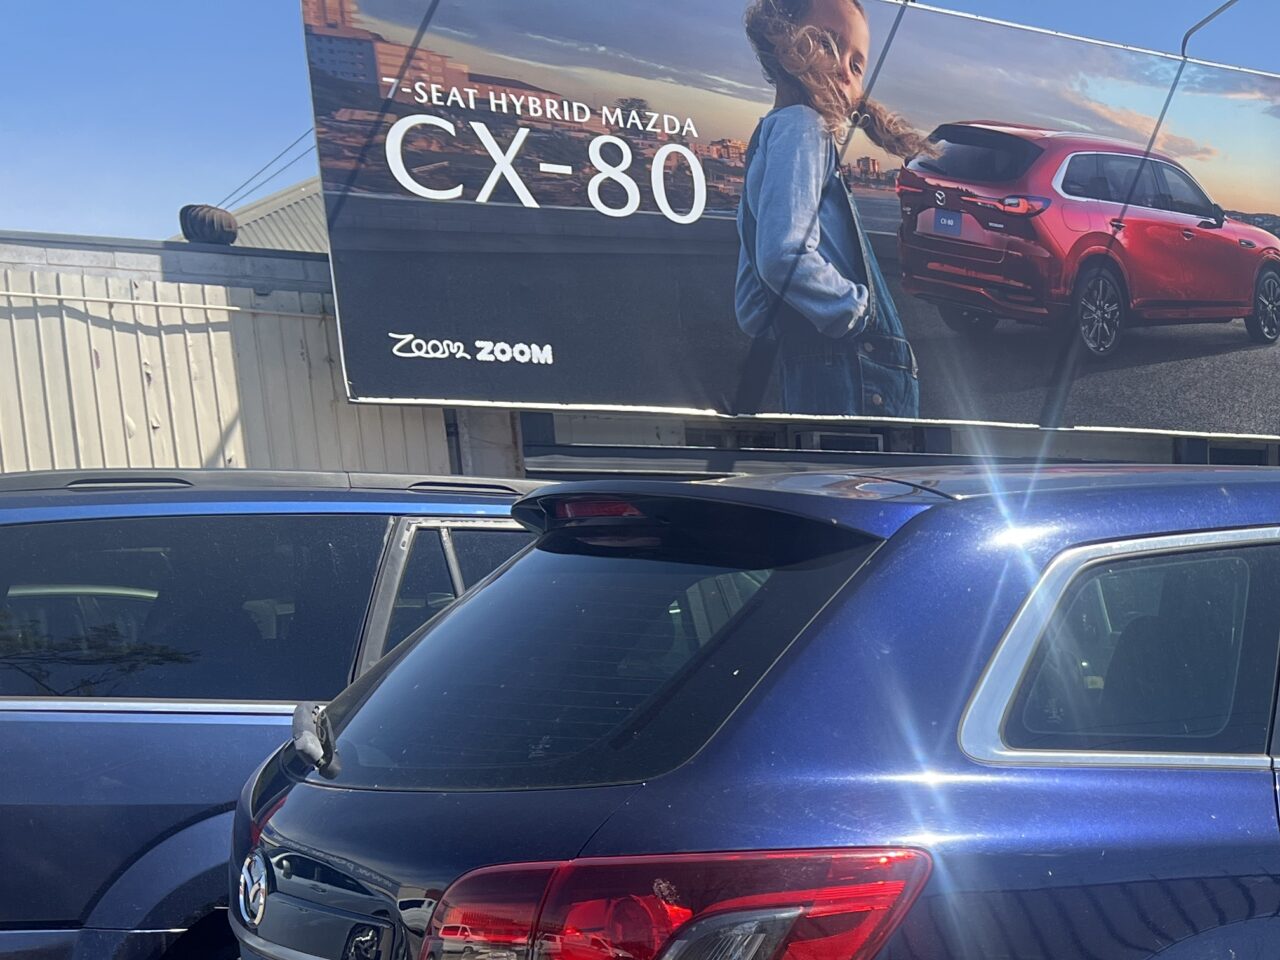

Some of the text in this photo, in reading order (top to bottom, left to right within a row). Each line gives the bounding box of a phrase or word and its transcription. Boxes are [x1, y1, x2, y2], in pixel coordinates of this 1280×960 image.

[382, 77, 699, 138] 7-SEAT HYBRID MAZDA
[384, 112, 708, 225] CX-80
[475, 340, 554, 365] ZOOM
